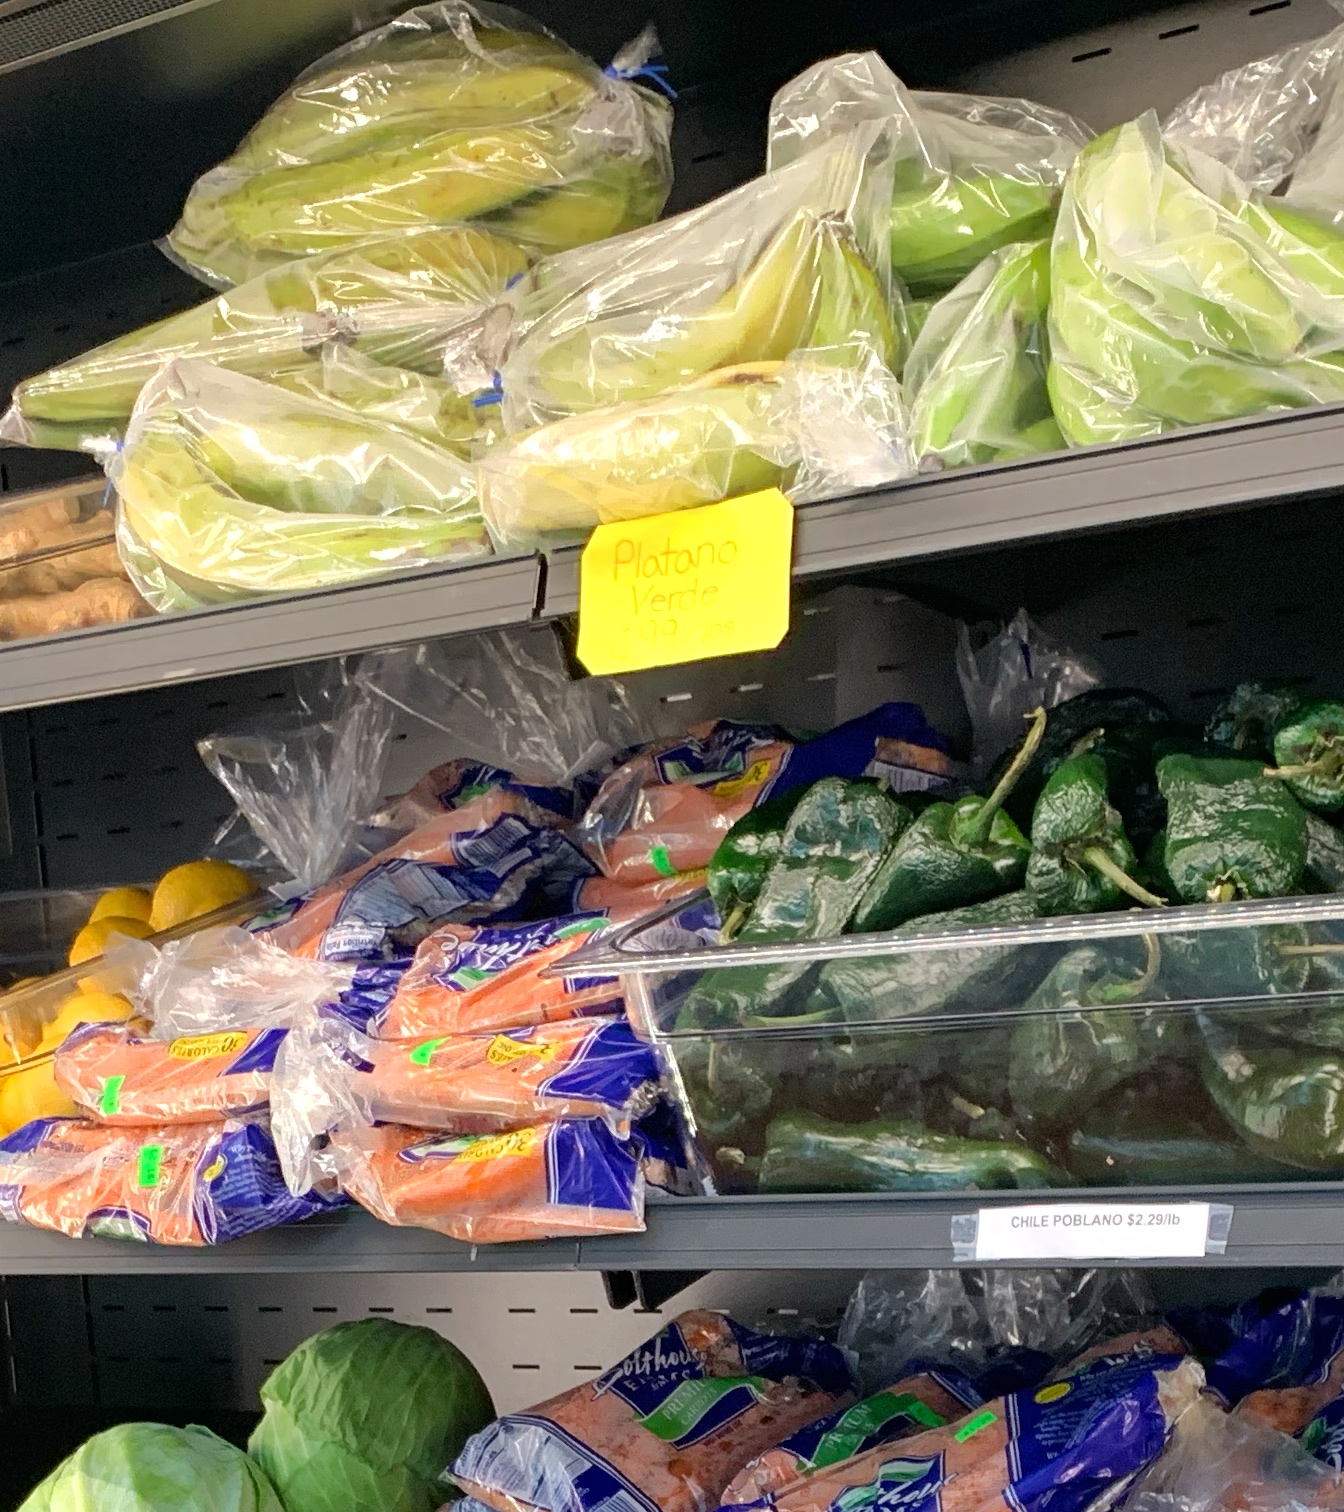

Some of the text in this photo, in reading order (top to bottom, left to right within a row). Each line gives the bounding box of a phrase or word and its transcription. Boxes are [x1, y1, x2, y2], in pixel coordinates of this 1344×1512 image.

[613, 538, 739, 581] Platano
[632, 579, 719, 616] Verde
[1011, 1213, 1181, 1229] CHILE POBLANO $2.29/lb
